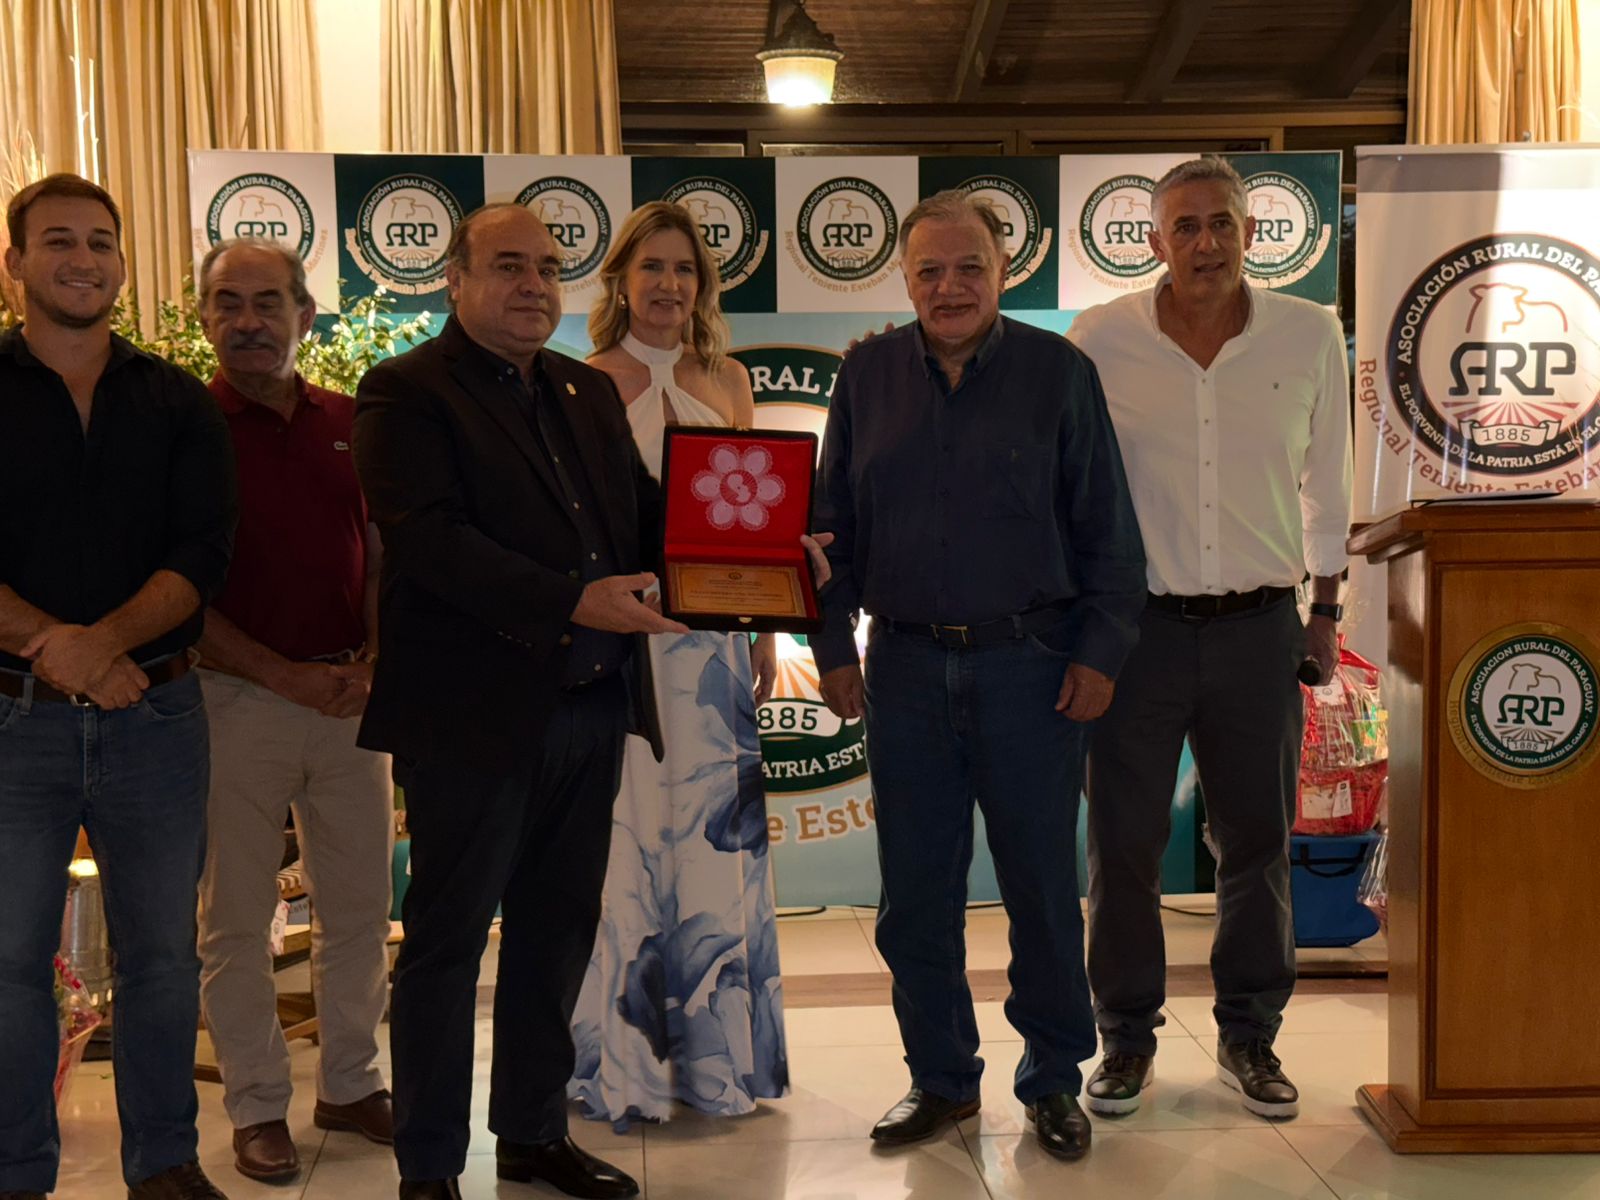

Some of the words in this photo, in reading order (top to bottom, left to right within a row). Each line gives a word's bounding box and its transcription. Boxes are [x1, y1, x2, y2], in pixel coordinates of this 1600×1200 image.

[238, 176, 270, 189] RURAL
[269, 178, 289, 193] DEL
[285, 187, 311, 233] PARAGUAY
[389, 177, 421, 190] RURAL
[420, 180, 439, 194] DEL
[538, 180, 568, 191] RURAL
[568, 182, 586, 196] DEL
[583, 190, 606, 234] PARAGUAY
[683, 179, 714, 191] RURAL
[714, 182, 732, 196] DEL
[729, 190, 752, 234] PARAGUAY
[827, 179, 858, 191] RURAL
[857, 181, 875, 195] DEL
[871, 189, 896, 233] PARAGUAY
[970, 179, 999, 190] RURAL
[998, 180, 1017, 195] DEL
[1013, 189, 1036, 232] PARAGUAY
[1110, 176, 1140, 189] RURAL
[1250, 175, 1280, 187] RURAL
[1279, 177, 1297, 192] DEL
[1292, 185, 1317, 230] PARAGUAY
[386, 222, 438, 246] ARP
[545, 224, 585, 247] RP
[823, 223, 872, 247] ARP
[782, 230, 808, 275] Regional
[805, 271, 848, 293] Teniente
[850, 271, 889, 292] Esteban
[1398, 256, 1470, 364] ASOCIACIÓN
[1473, 242, 1543, 266] RURAL
[1544, 247, 1582, 274] DEL
[750, 365, 820, 394] RAL
[1448, 341, 1576, 396] ARP
[1359, 358, 1410, 456] Regional
[1399, 383, 1411, 399] EL
[1405, 398, 1450, 448] PORVENIR
[1449, 443, 1468, 459] DE
[1468, 452, 1485, 466] LA
[1486, 456, 1534, 469] PATRIA
[1535, 445, 1567, 465] ESTÁ
[1565, 436, 1584, 454] EN
[1483, 429, 1531, 442] 1885
[1513, 641, 1551, 653] RURAL
[1552, 646, 1571, 662] DEL
[1569, 658, 1594, 713] PARAGUAY
[758, 707, 818, 730] 885
[1497, 694, 1565, 726] ARP
[762, 758, 825, 778] ATRIA
[825, 742, 864, 770] EST
[1514, 742, 1538, 750] 1885
